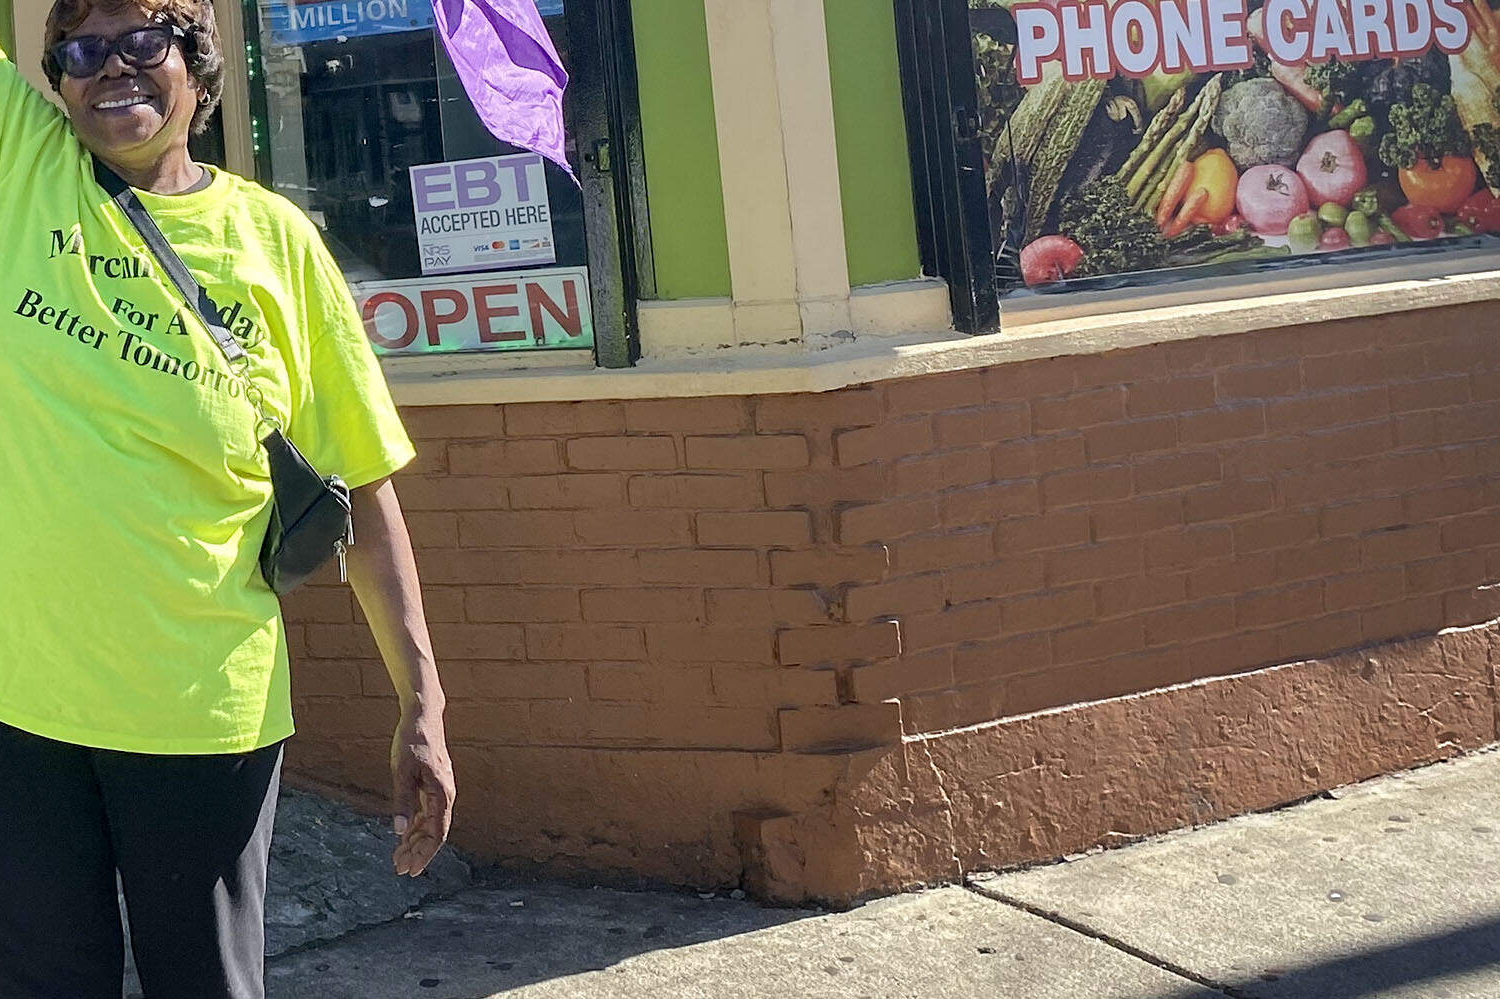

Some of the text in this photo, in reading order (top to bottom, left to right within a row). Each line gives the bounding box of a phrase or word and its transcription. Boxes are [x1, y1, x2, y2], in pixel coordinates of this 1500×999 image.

[413, 156, 542, 213] EBT
[421, 205, 549, 235] ACCEPTED HERE
[424, 255, 452, 268] PAY
[13, 287, 109, 350] Better
[112, 296, 189, 336] For A
[362, 279, 583, 350] OPEN
